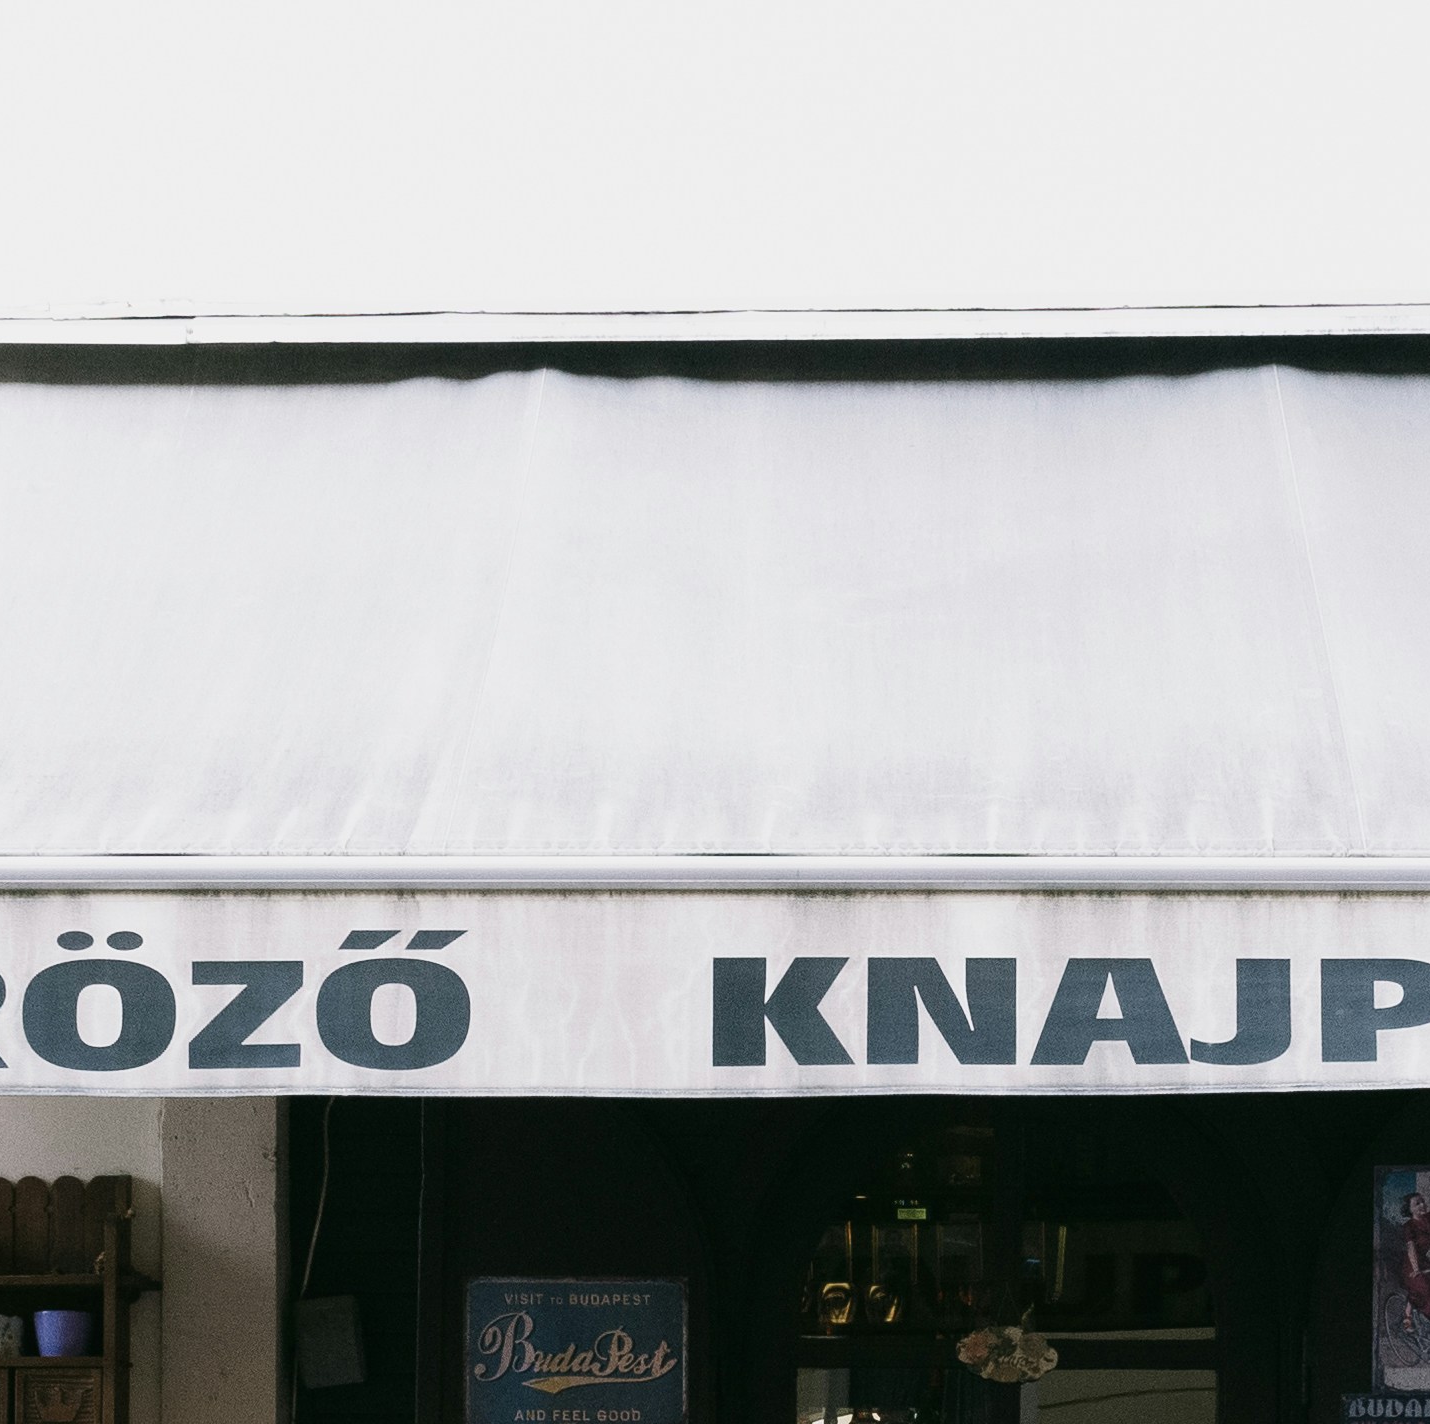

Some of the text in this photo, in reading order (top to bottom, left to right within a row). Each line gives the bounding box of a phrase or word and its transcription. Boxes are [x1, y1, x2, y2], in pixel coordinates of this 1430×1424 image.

[504, 1293, 544, 1305] VISIT
[569, 1293, 651, 1305] BUDAPEST
[473, 1310, 678, 1383] BudaPest
[514, 1408, 641, 1422] AND FEEL GOOD
